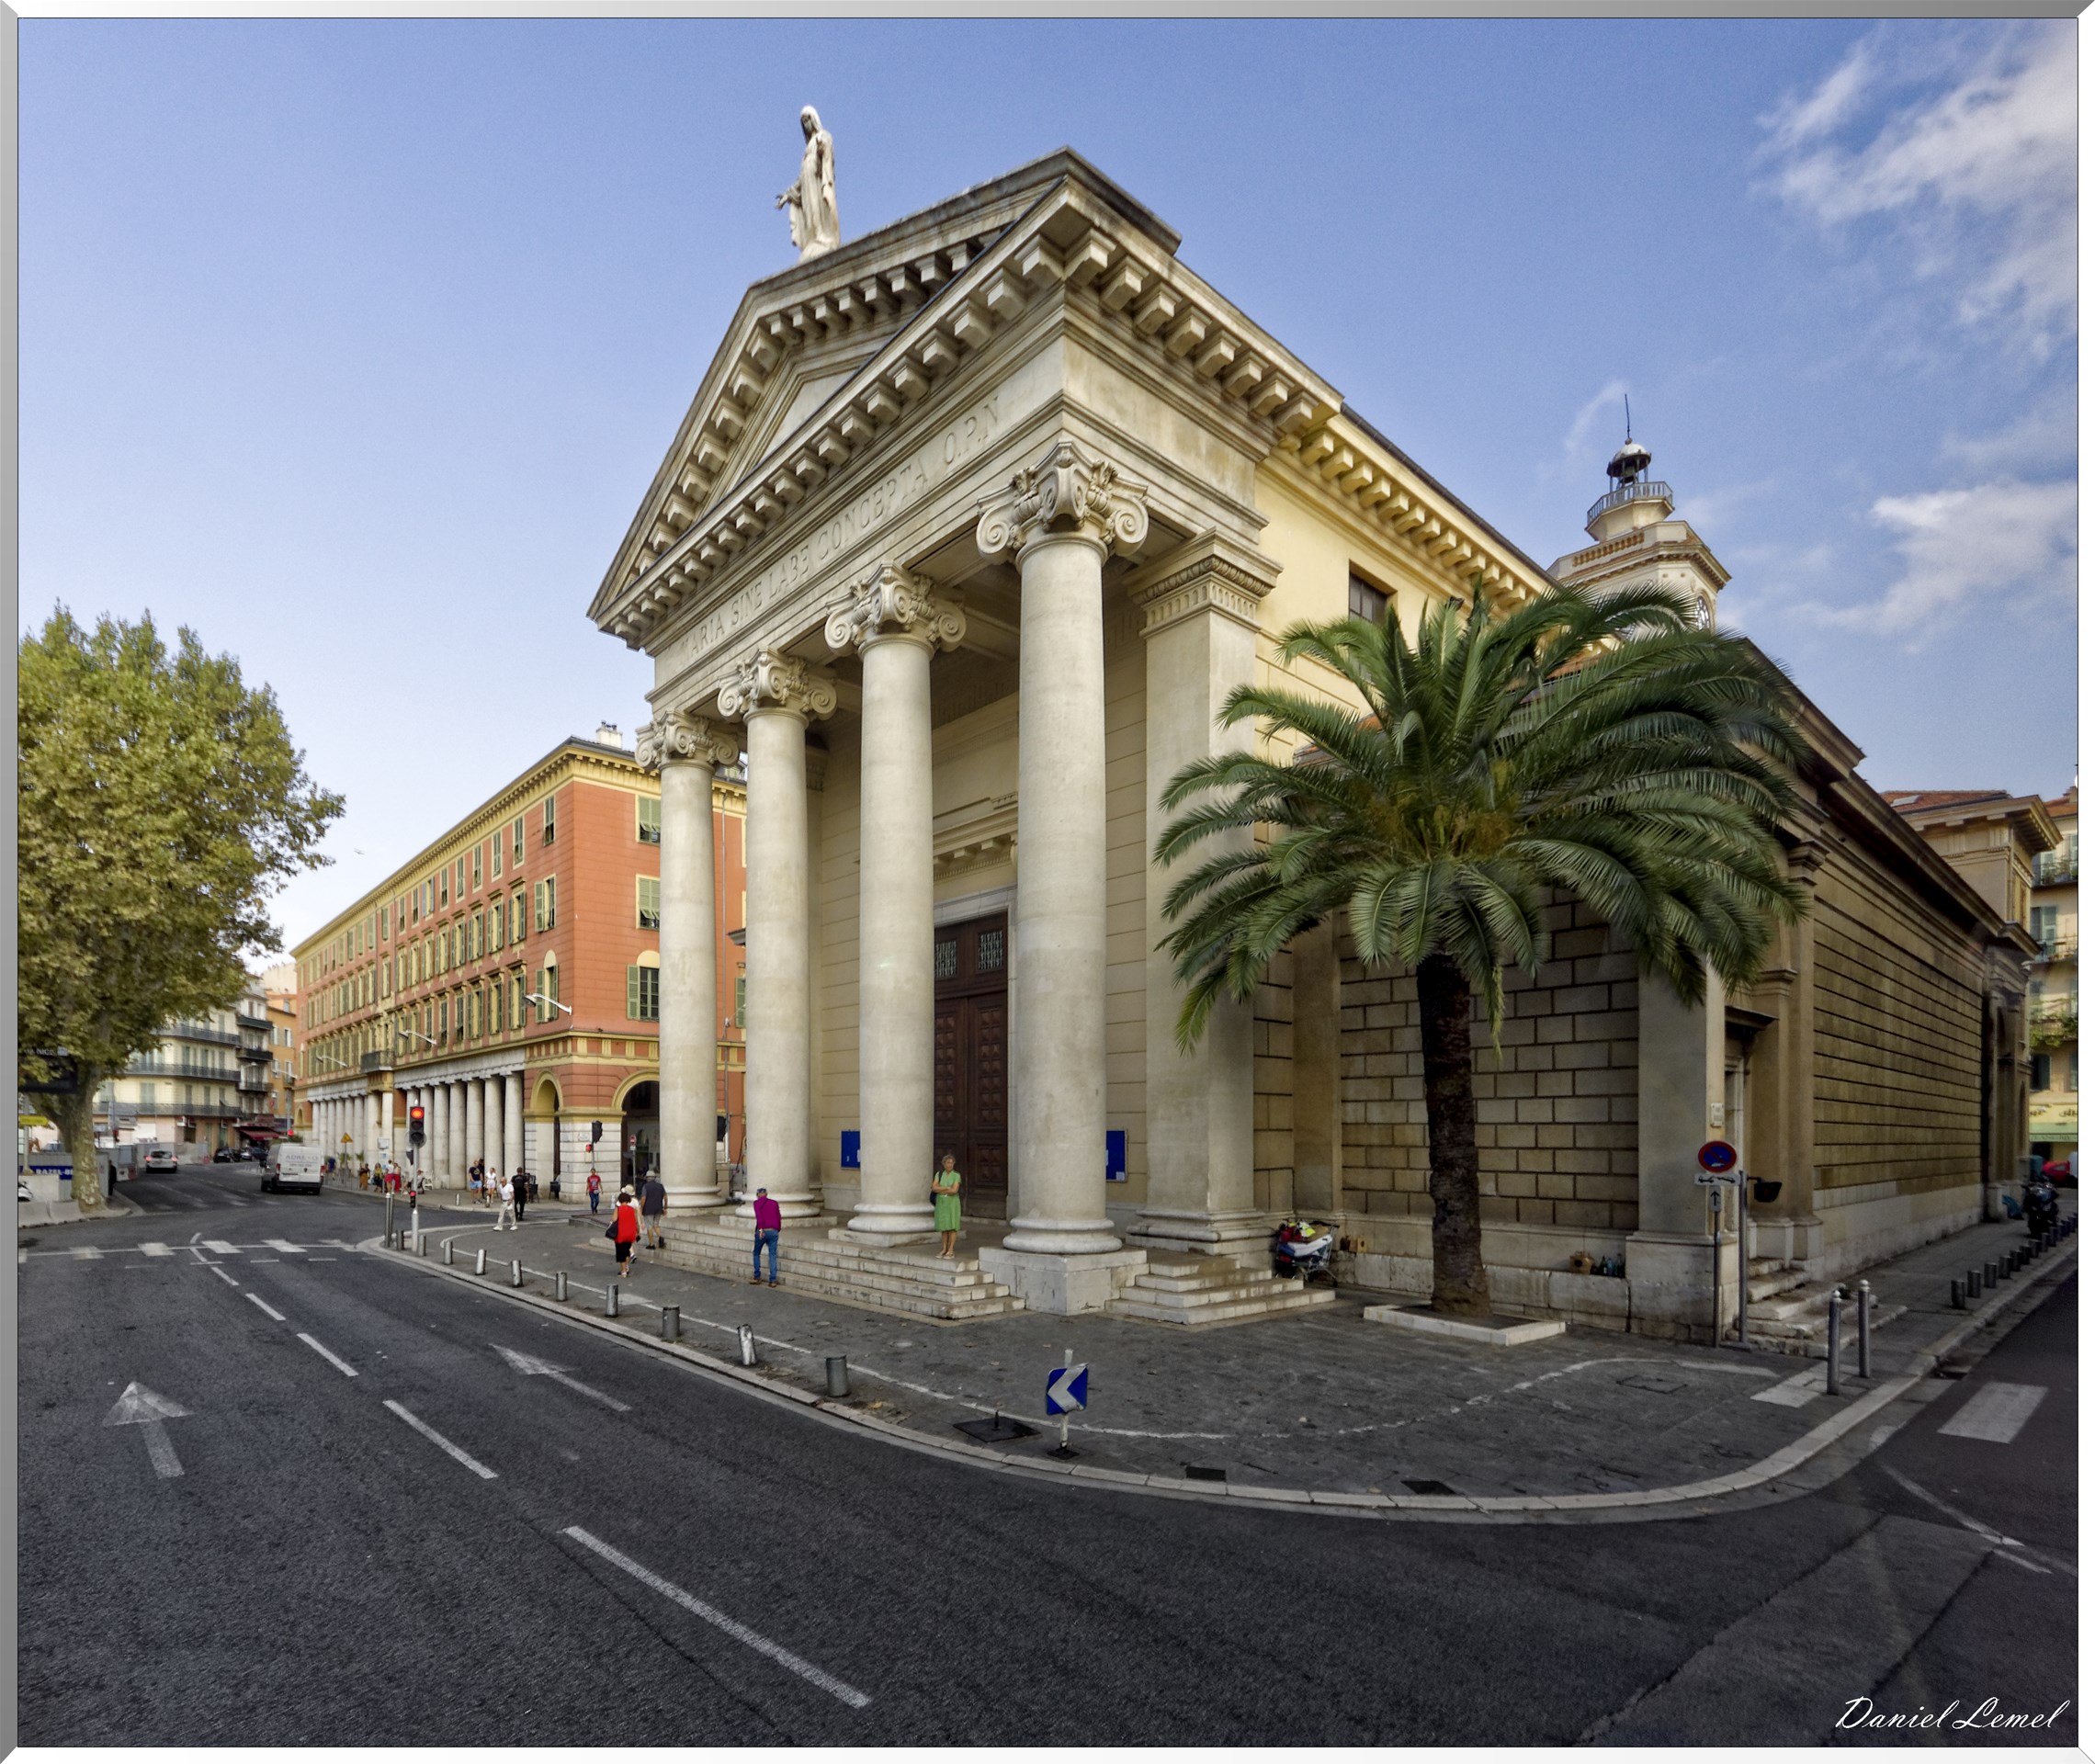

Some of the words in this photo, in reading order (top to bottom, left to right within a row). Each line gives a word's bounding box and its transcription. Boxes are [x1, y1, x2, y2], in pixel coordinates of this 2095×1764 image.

[730, 582, 762, 627] SINE
[769, 546, 809, 597] LABE
[818, 459, 928, 560] CONCEPTA
